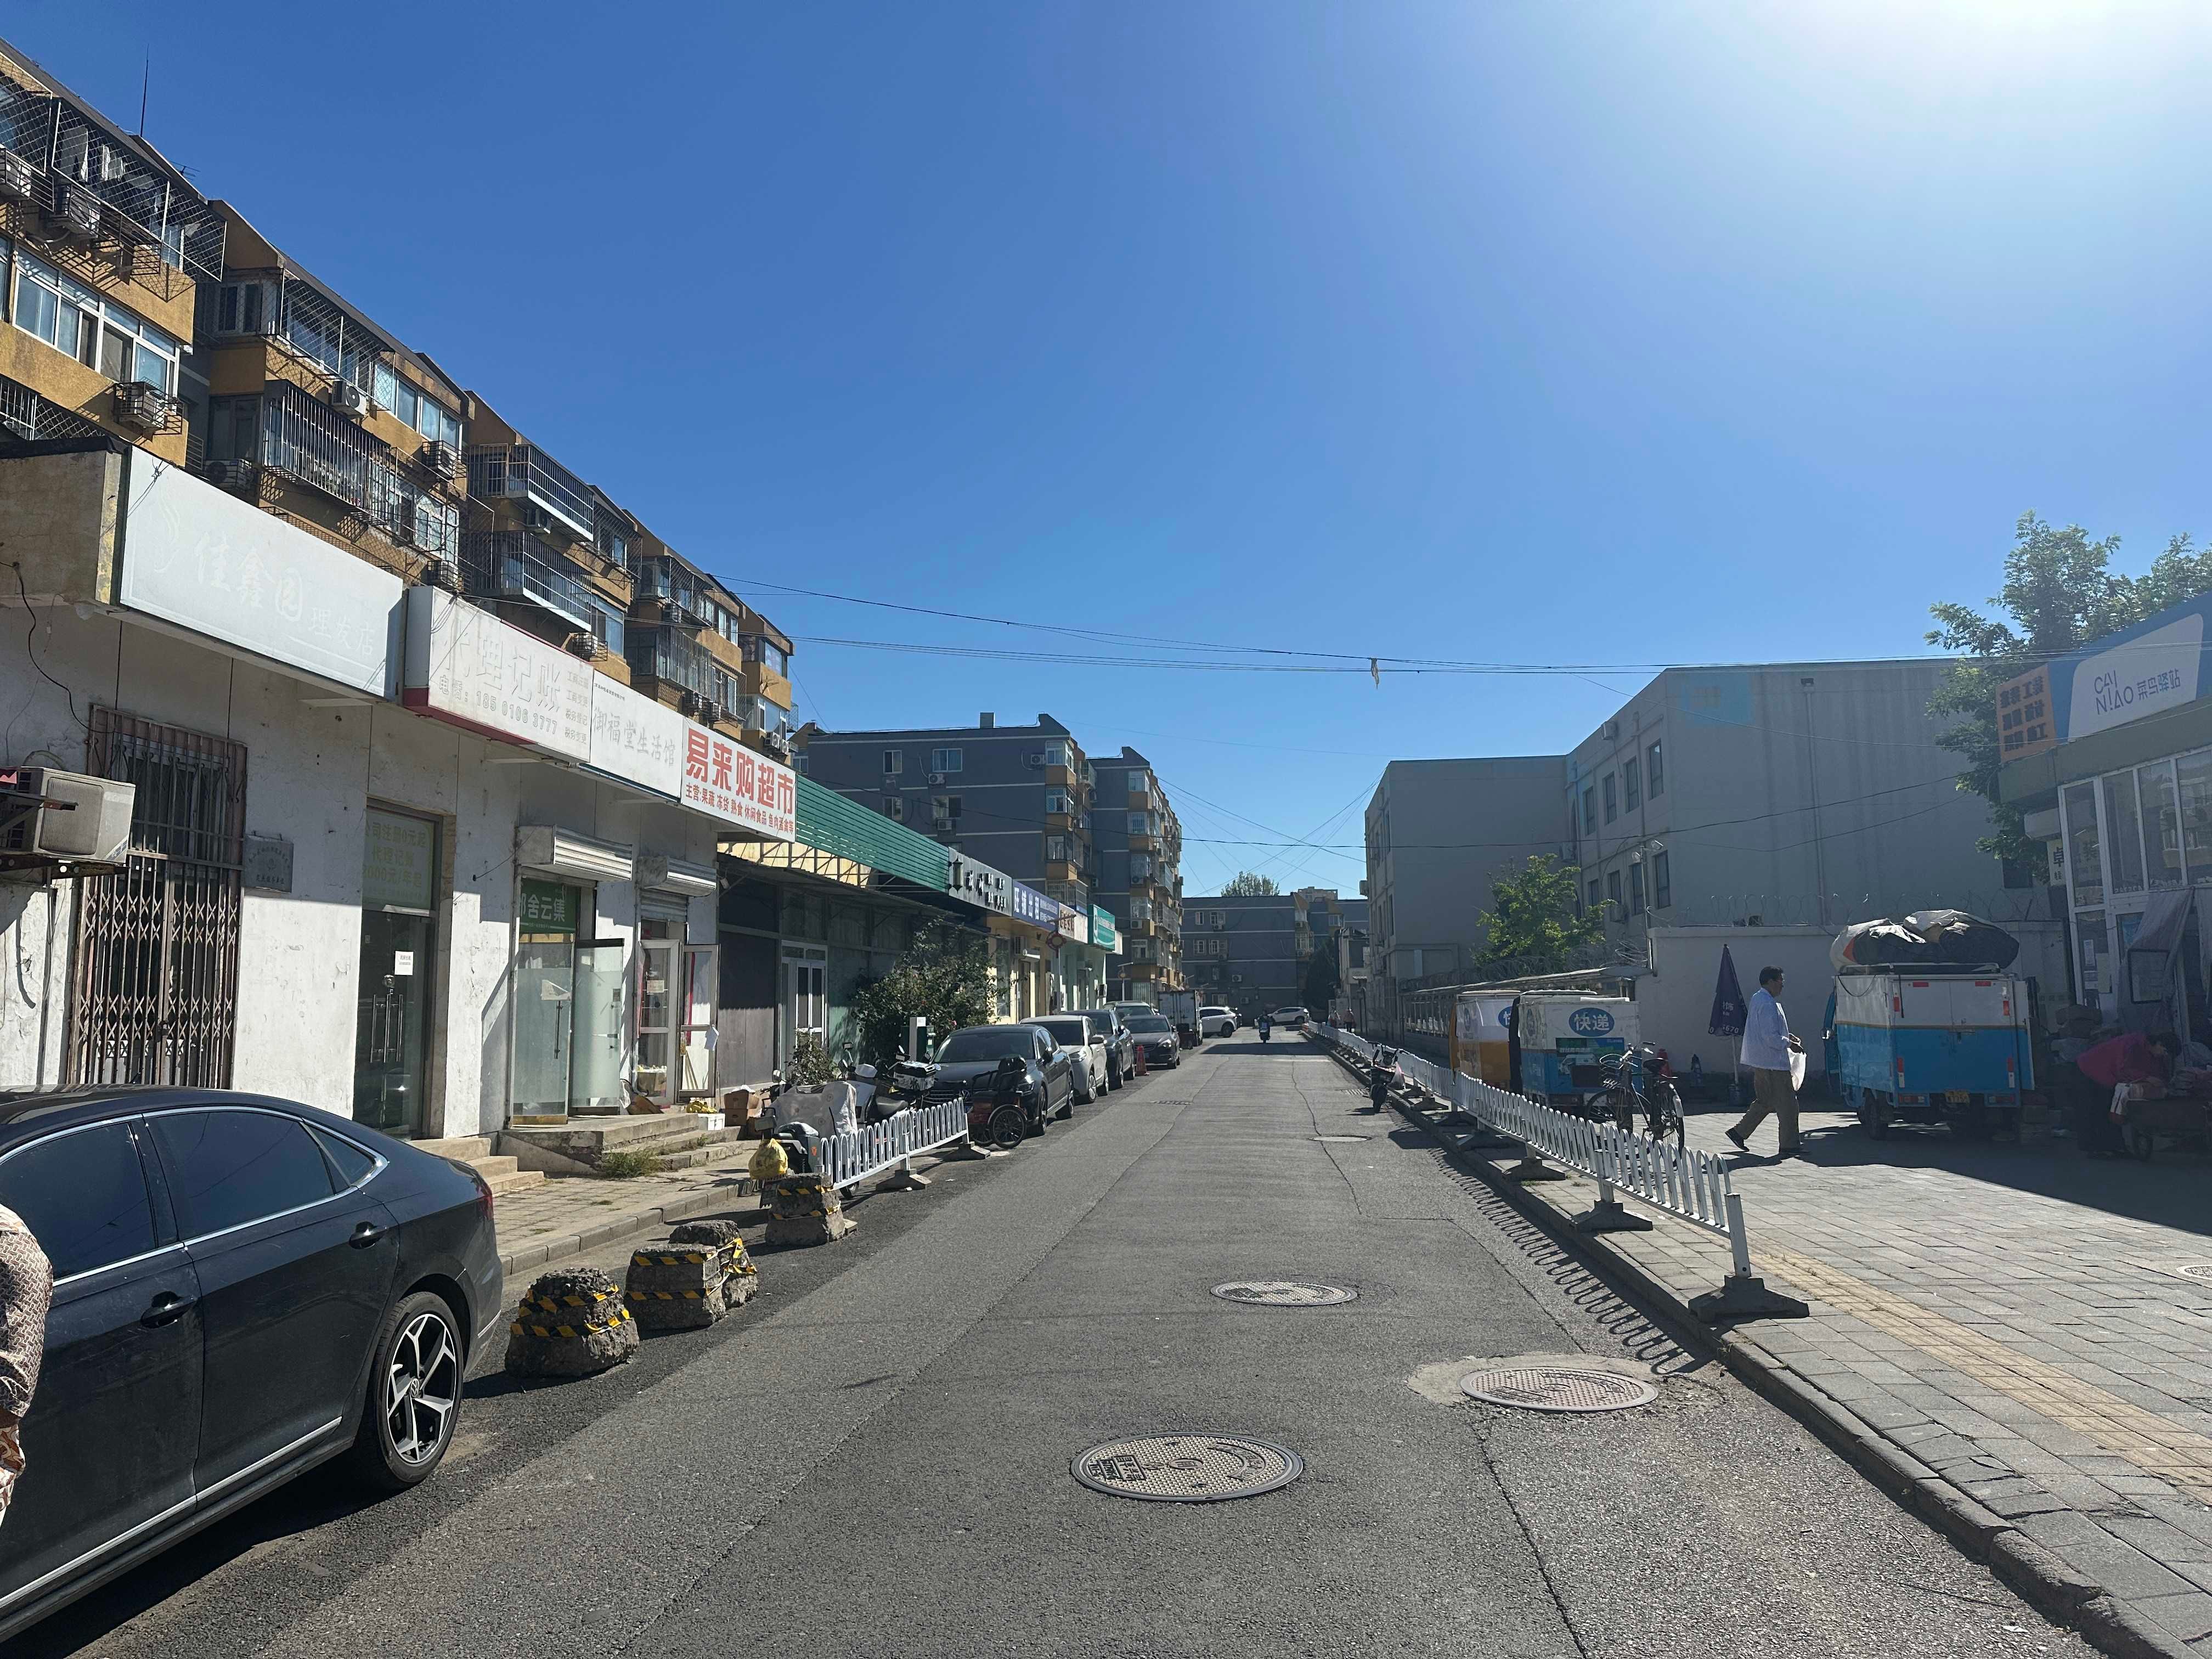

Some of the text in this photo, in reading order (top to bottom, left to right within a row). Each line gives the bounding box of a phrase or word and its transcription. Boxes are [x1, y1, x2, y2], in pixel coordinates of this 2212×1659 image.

[2094, 670, 2117, 695] CAI
[2137, 668, 2181, 701] 菜鸟驿站
[476, 690, 496, 712] 185
[686, 728, 794, 815] 易来购超市
[1014, 887, 1040, 921] 旺铺出租
[1575, 1012, 1610, 1032] 快递
